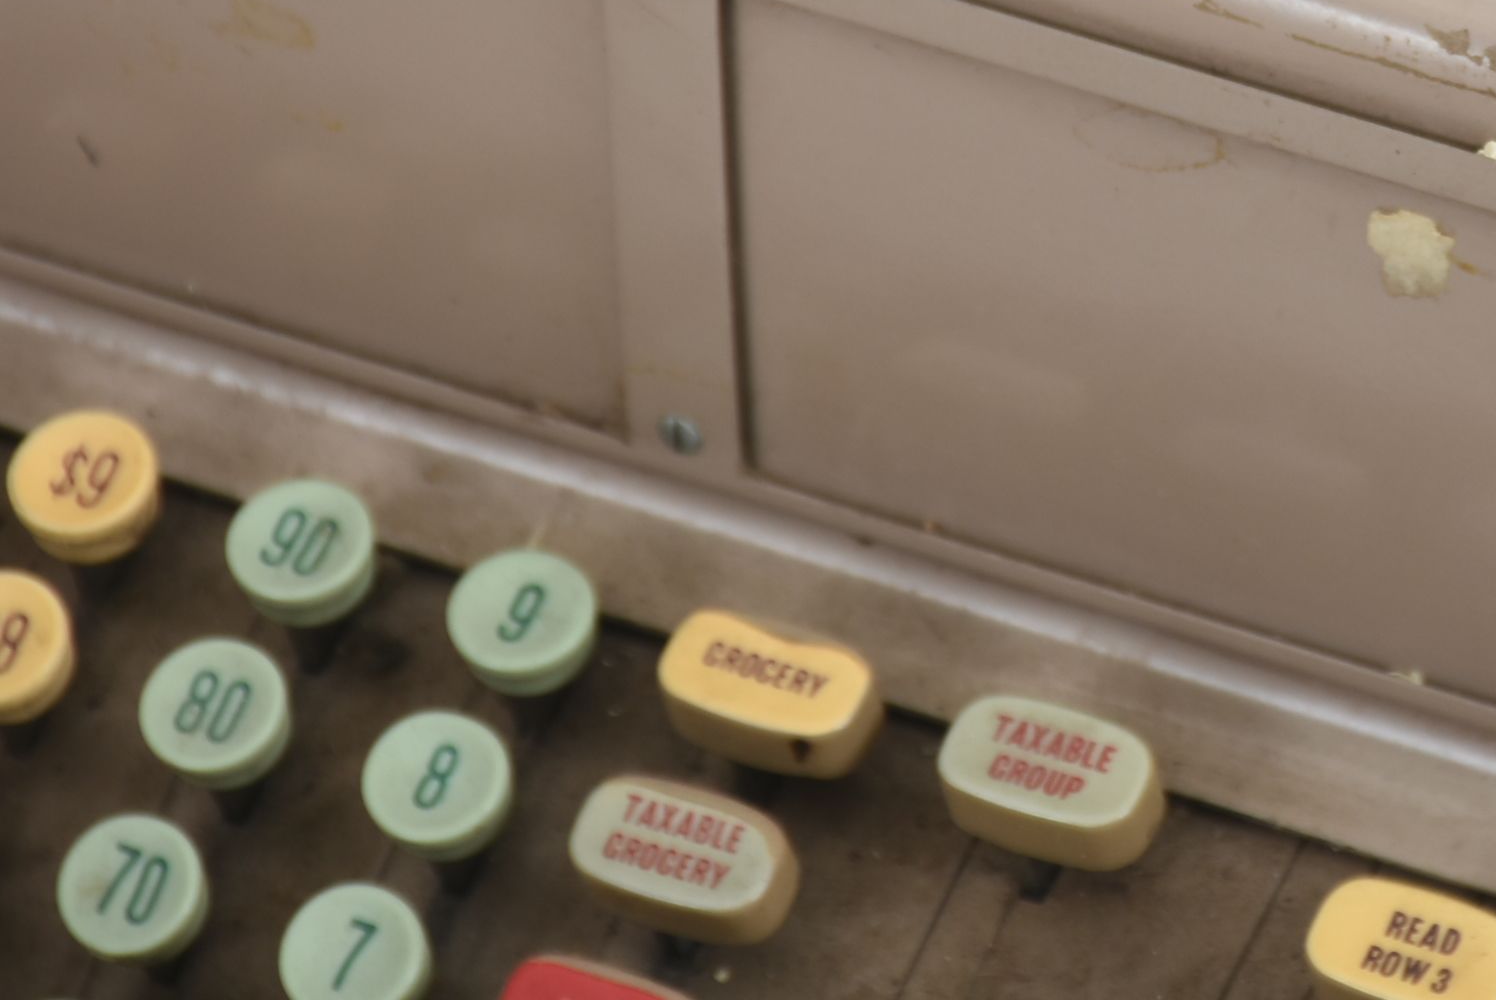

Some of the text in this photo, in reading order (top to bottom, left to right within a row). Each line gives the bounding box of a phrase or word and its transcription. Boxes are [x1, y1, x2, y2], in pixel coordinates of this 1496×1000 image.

[49, 444, 119, 510] $9
[260, 507, 340, 577] 90
[496, 582, 546, 643] 9
[702, 641, 831, 699] GROCERY
[173, 669, 253, 744] 80
[992, 713, 1120, 775] TAXABLE
[411, 742, 459, 811] 8
[986, 753, 1088, 800] GROUP
[621, 793, 748, 856] TAXABLE
[96, 840, 169, 926] 70
[603, 831, 733, 890] GROCERY
[331, 917, 379, 993] 7
[1384, 910, 1462, 956] READ
[1360, 944, 1453, 995] ROW 3
